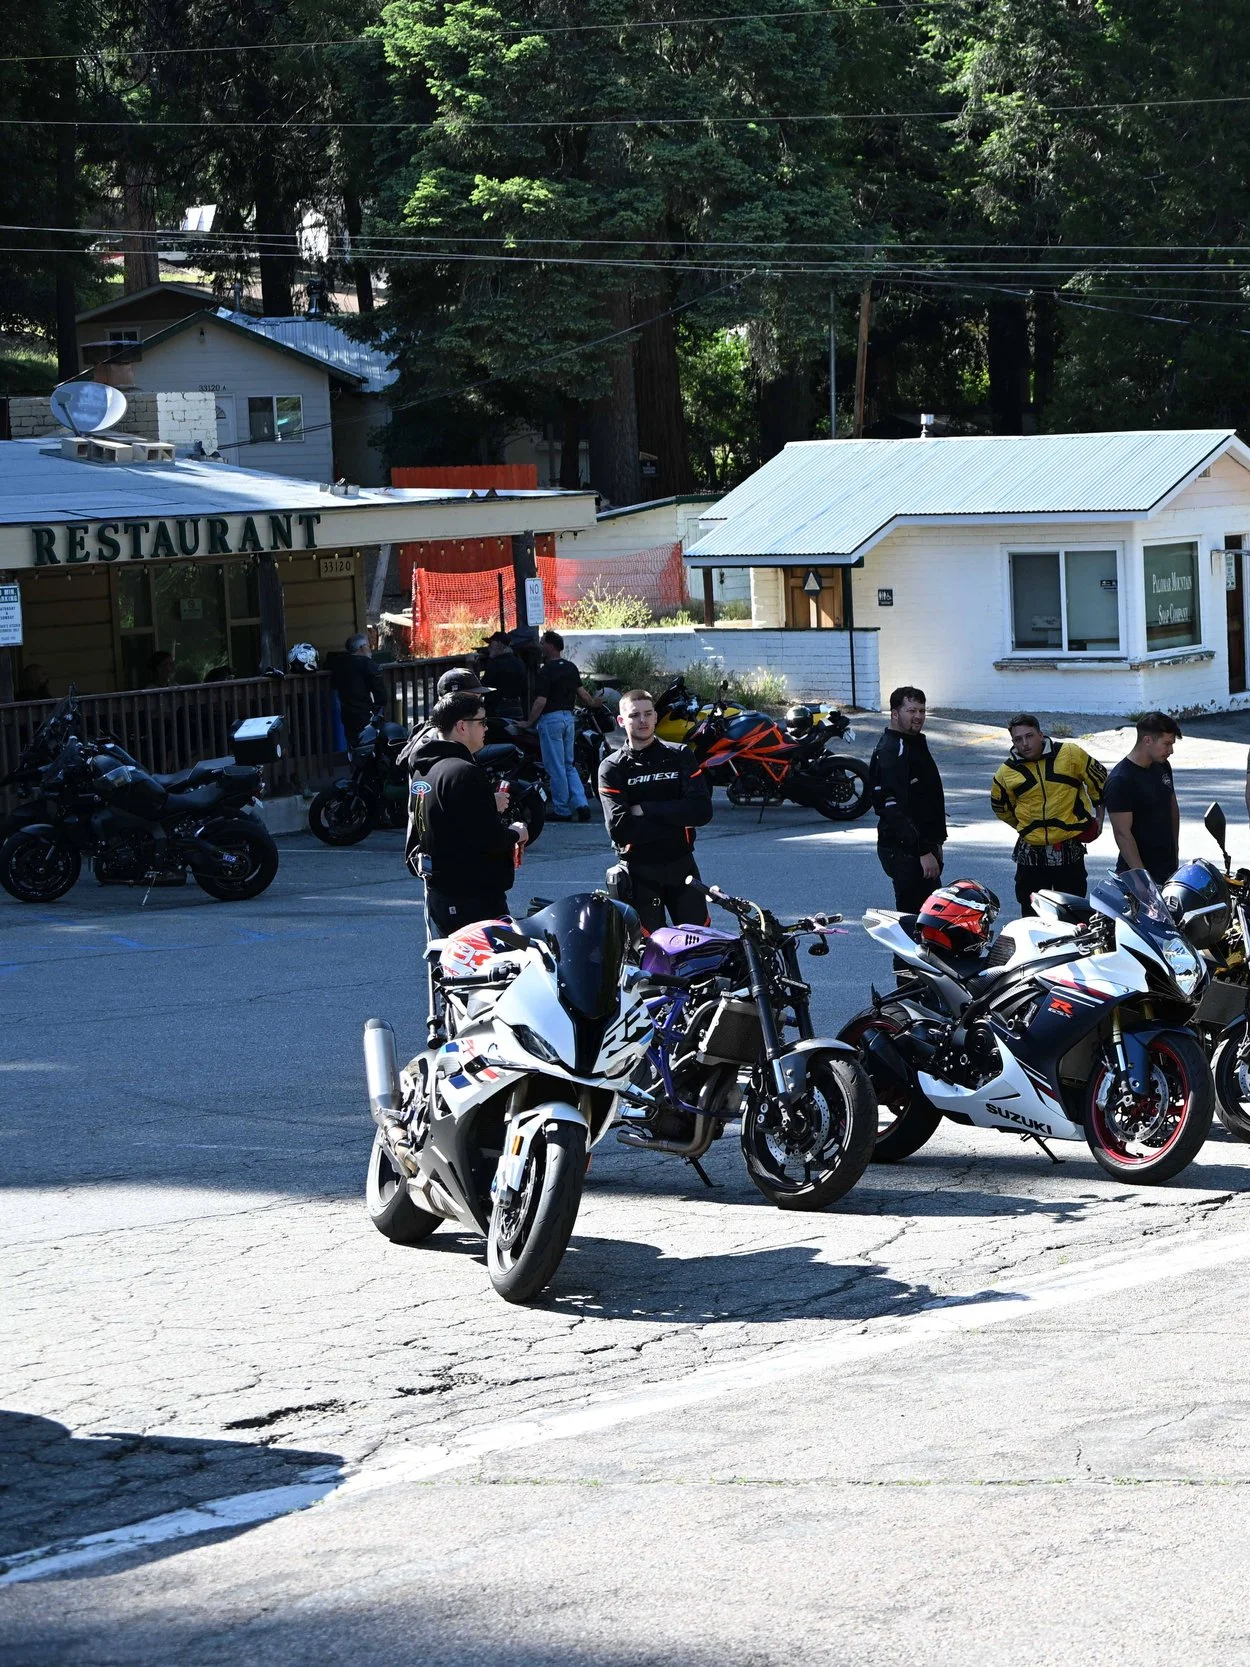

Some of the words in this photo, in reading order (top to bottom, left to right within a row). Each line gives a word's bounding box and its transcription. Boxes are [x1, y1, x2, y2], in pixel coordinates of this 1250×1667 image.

[31, 513, 321, 566] RESTAURANT
[323, 560, 350, 572] 33120
[529, 583, 540, 595] NO
[627, 771, 680, 786] DAINESE
[1050, 998, 1073, 1014] R
[985, 1103, 1053, 1135] SUZUKI
